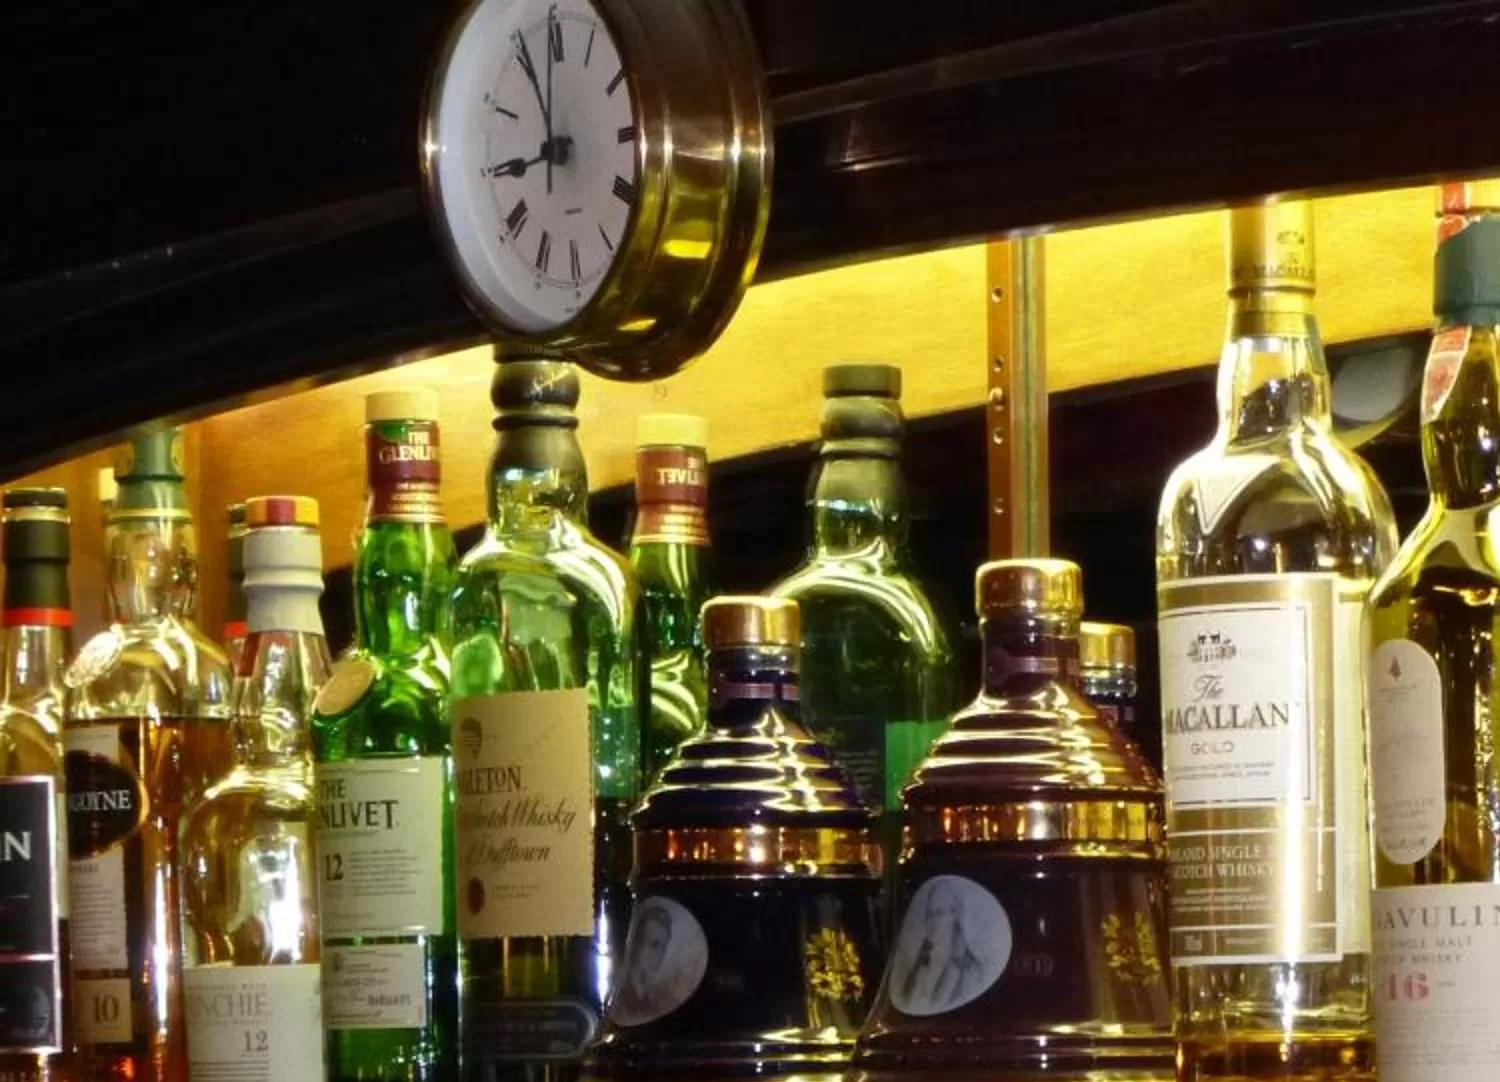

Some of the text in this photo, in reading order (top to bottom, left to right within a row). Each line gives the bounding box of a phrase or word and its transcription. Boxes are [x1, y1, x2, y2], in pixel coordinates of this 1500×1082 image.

[1192, 673, 1225, 703] The
[1191, 740, 1235, 755] GOLD
[324, 853, 344, 882] 12
[1386, 973, 1431, 1001] 16
[95, 994, 120, 1025] 10
[243, 1029, 270, 1053] 12
